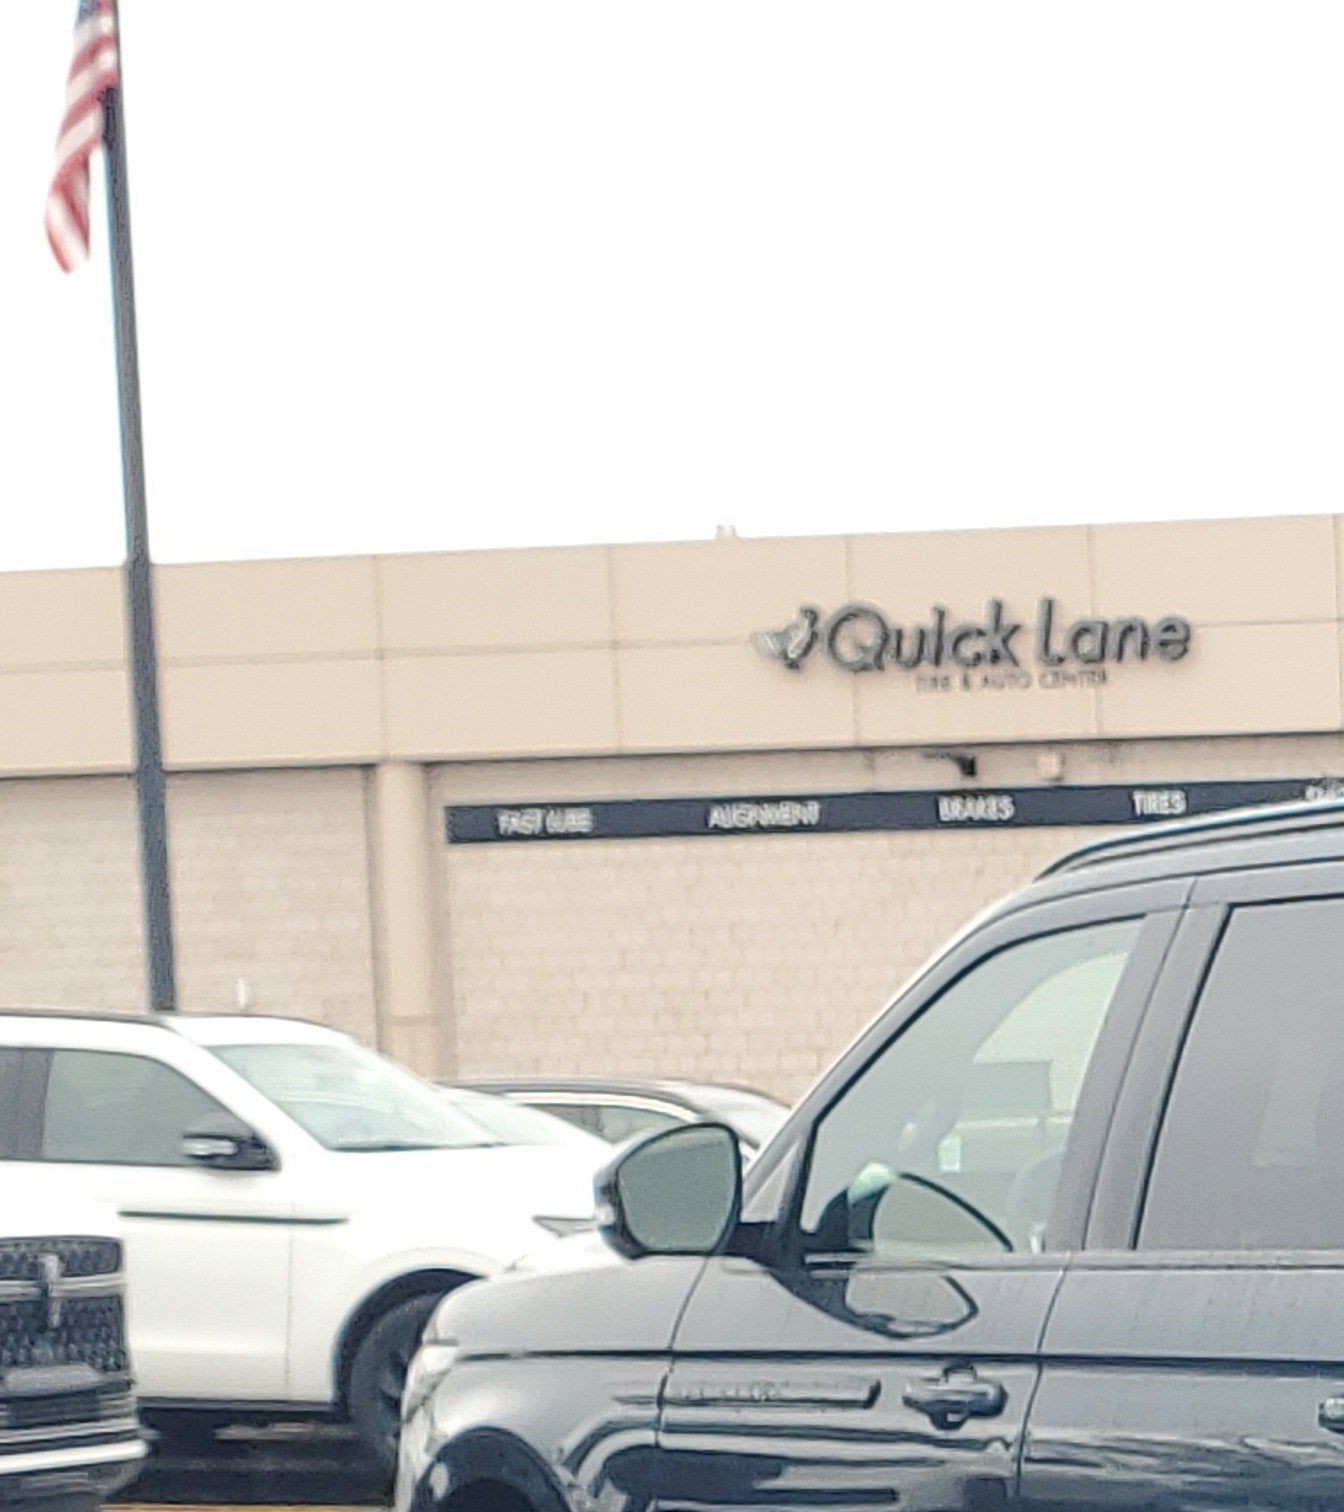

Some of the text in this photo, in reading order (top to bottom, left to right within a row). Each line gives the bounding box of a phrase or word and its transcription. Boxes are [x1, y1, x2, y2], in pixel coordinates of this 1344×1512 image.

[825, 597, 1191, 672] Quick Lane
[1133, 789, 1187, 815] TIRES
